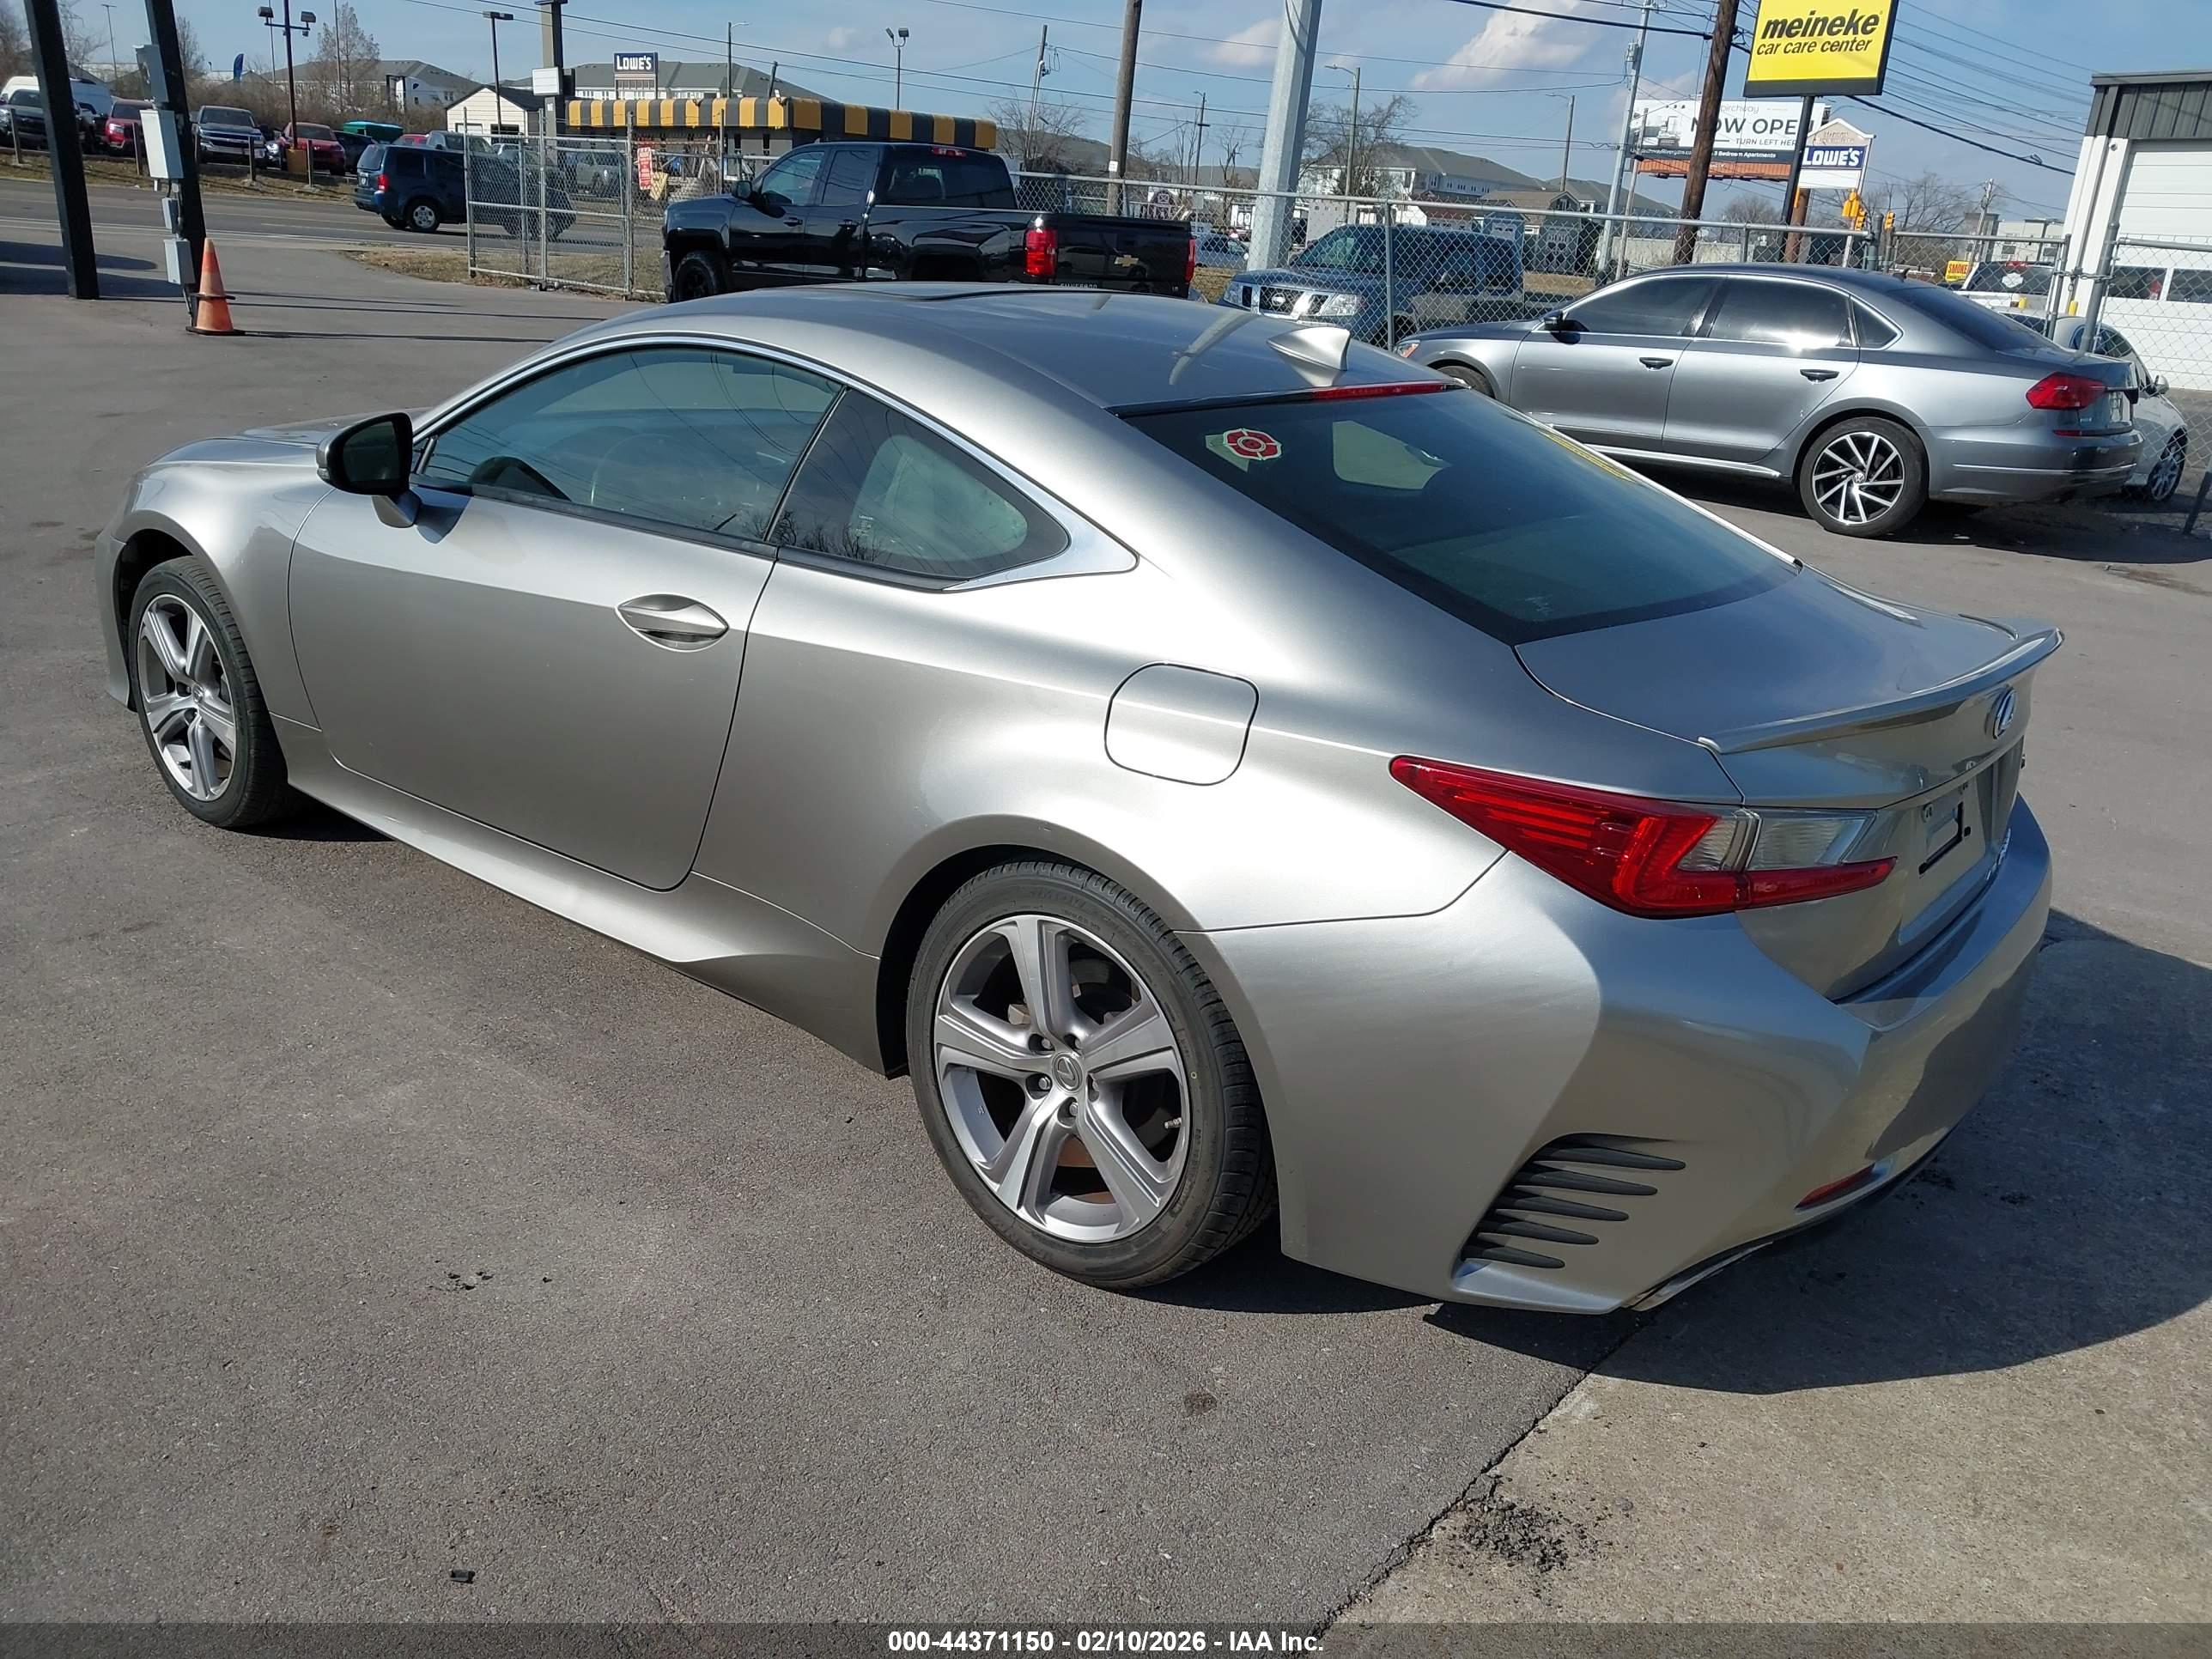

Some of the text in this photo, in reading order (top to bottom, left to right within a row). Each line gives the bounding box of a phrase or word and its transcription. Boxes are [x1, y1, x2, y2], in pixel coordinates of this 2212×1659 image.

[1760, 9, 1881, 40] meineke
[1756, 36, 1874, 56] car care center
[617, 55, 652, 70] LOWE'S
[1802, 147, 1862, 167] LOWE'S
